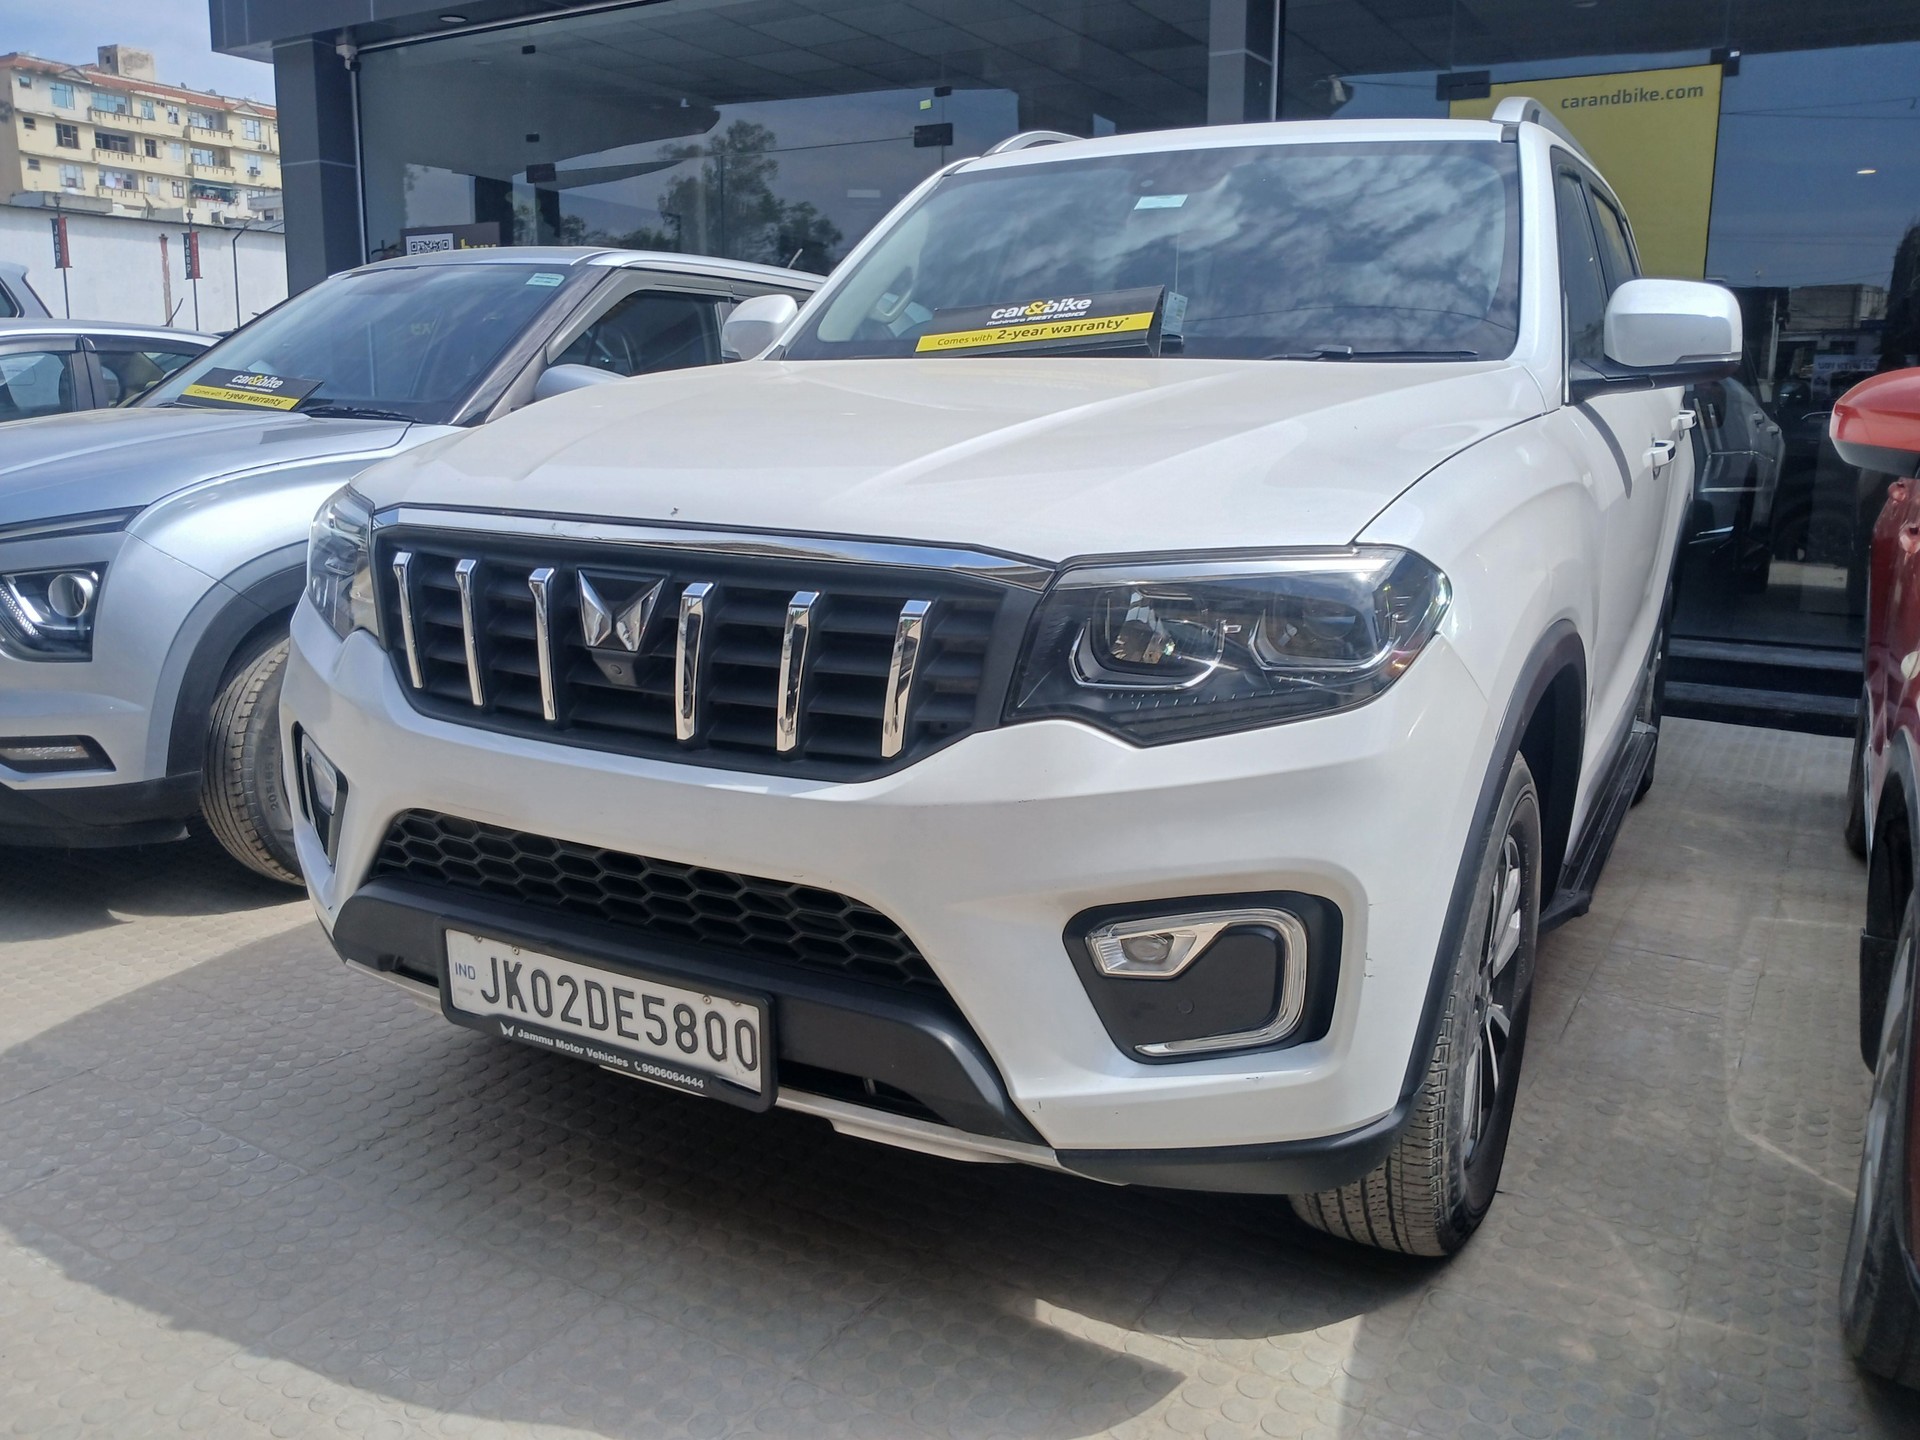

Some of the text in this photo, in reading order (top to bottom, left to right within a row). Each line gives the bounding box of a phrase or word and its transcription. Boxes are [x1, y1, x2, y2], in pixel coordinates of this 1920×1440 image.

[1561, 85, 1704, 109] carandbike.com
[990, 298, 1093, 320] car&bike
[1026, 314, 1052, 322] FIRST
[1053, 310, 1087, 319] CHOICE
[937, 336, 969, 346] Comes
[971, 333, 993, 343] with
[996, 326, 1048, 342] 2-year
[231, 374, 284, 389] car&bike
[223, 391, 248, 400] 1-year
[455, 962, 476, 981] IND
[481, 957, 758, 1072] JK02DE5800
[517, 1028, 705, 1089] Jammu Motor Vehicles 9906064444
